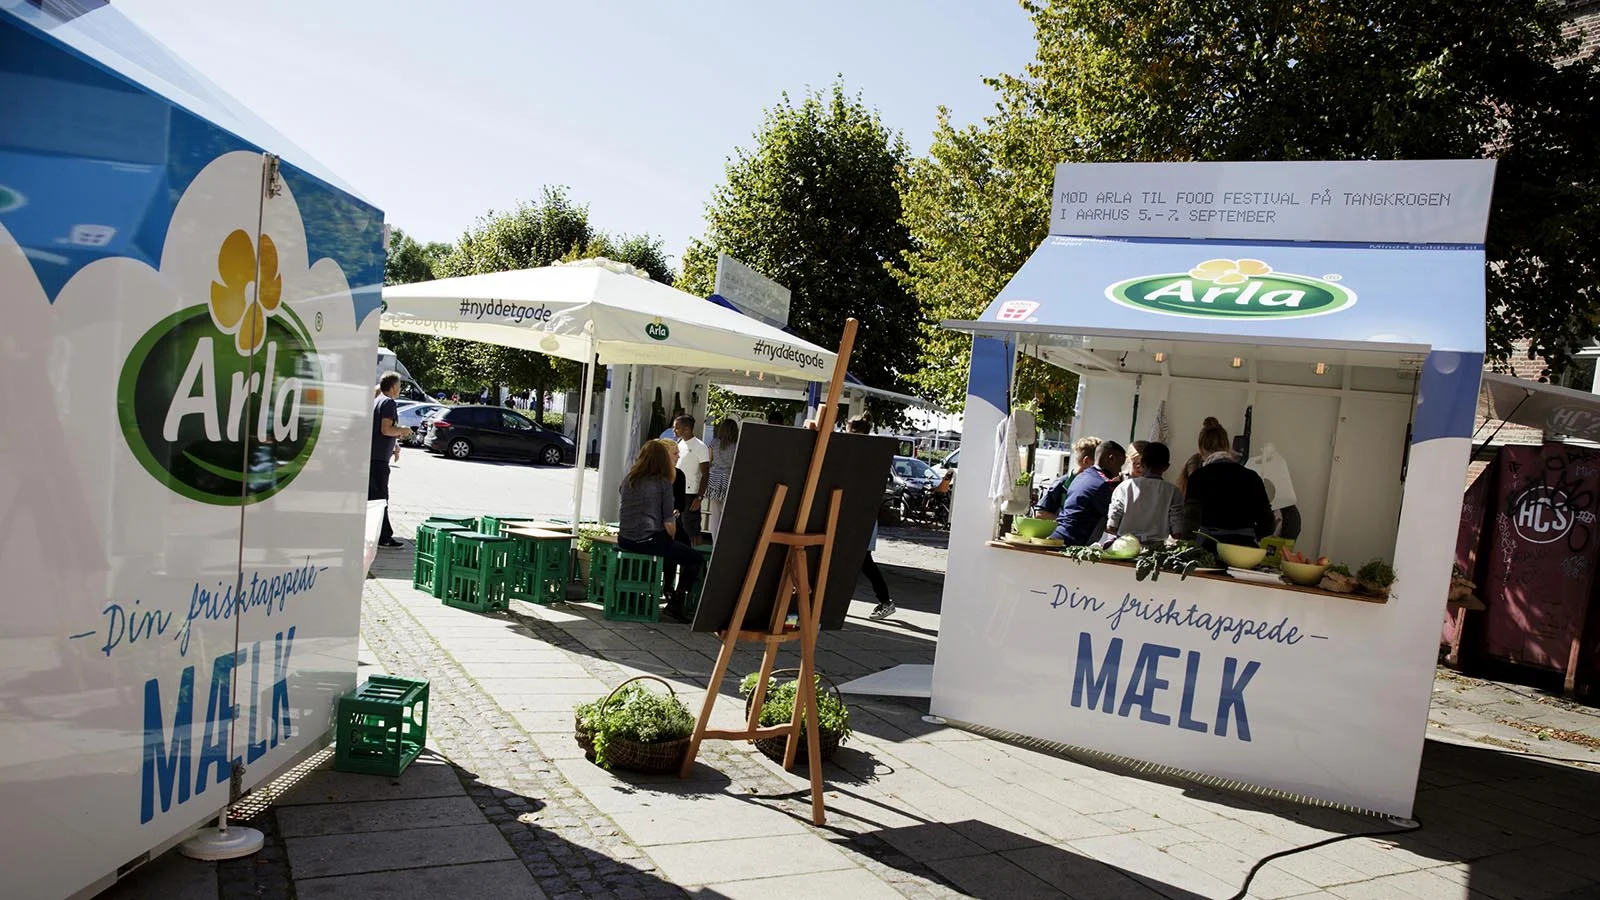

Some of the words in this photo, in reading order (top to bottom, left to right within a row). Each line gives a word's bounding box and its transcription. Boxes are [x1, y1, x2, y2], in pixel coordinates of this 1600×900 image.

[1061, 191, 1088, 204] MØD
[1096, 191, 1132, 204] ARLA
[1142, 191, 1166, 204] TIL
[1176, 191, 1214, 205] FOOD
[1223, 192, 1300, 206] FESTIVAL
[1310, 188, 1332, 206] PÅ
[1343, 192, 1451, 207] TANGKROGEN
[1060, 208, 1067, 220] I
[1076, 208, 1130, 221] AARHUS
[1189, 209, 1276, 223] SEPTEMBER
[1143, 279, 1306, 308] Arla
[459, 298, 552, 323] #nyddetgode
[648, 324, 667, 337] Arla
[753, 339, 824, 369] #nyddetgode
[163, 336, 302, 442] Arla
[1518, 497, 1568, 533] HCS
[102, 599, 172, 657] Din
[174, 555, 318, 657] frisktappede
[1050, 583, 1105, 612] Din
[1106, 592, 1304, 645] frisktappede
[1070, 631, 1261, 742] MÆLK
[140, 625, 296, 825] MÆLK
